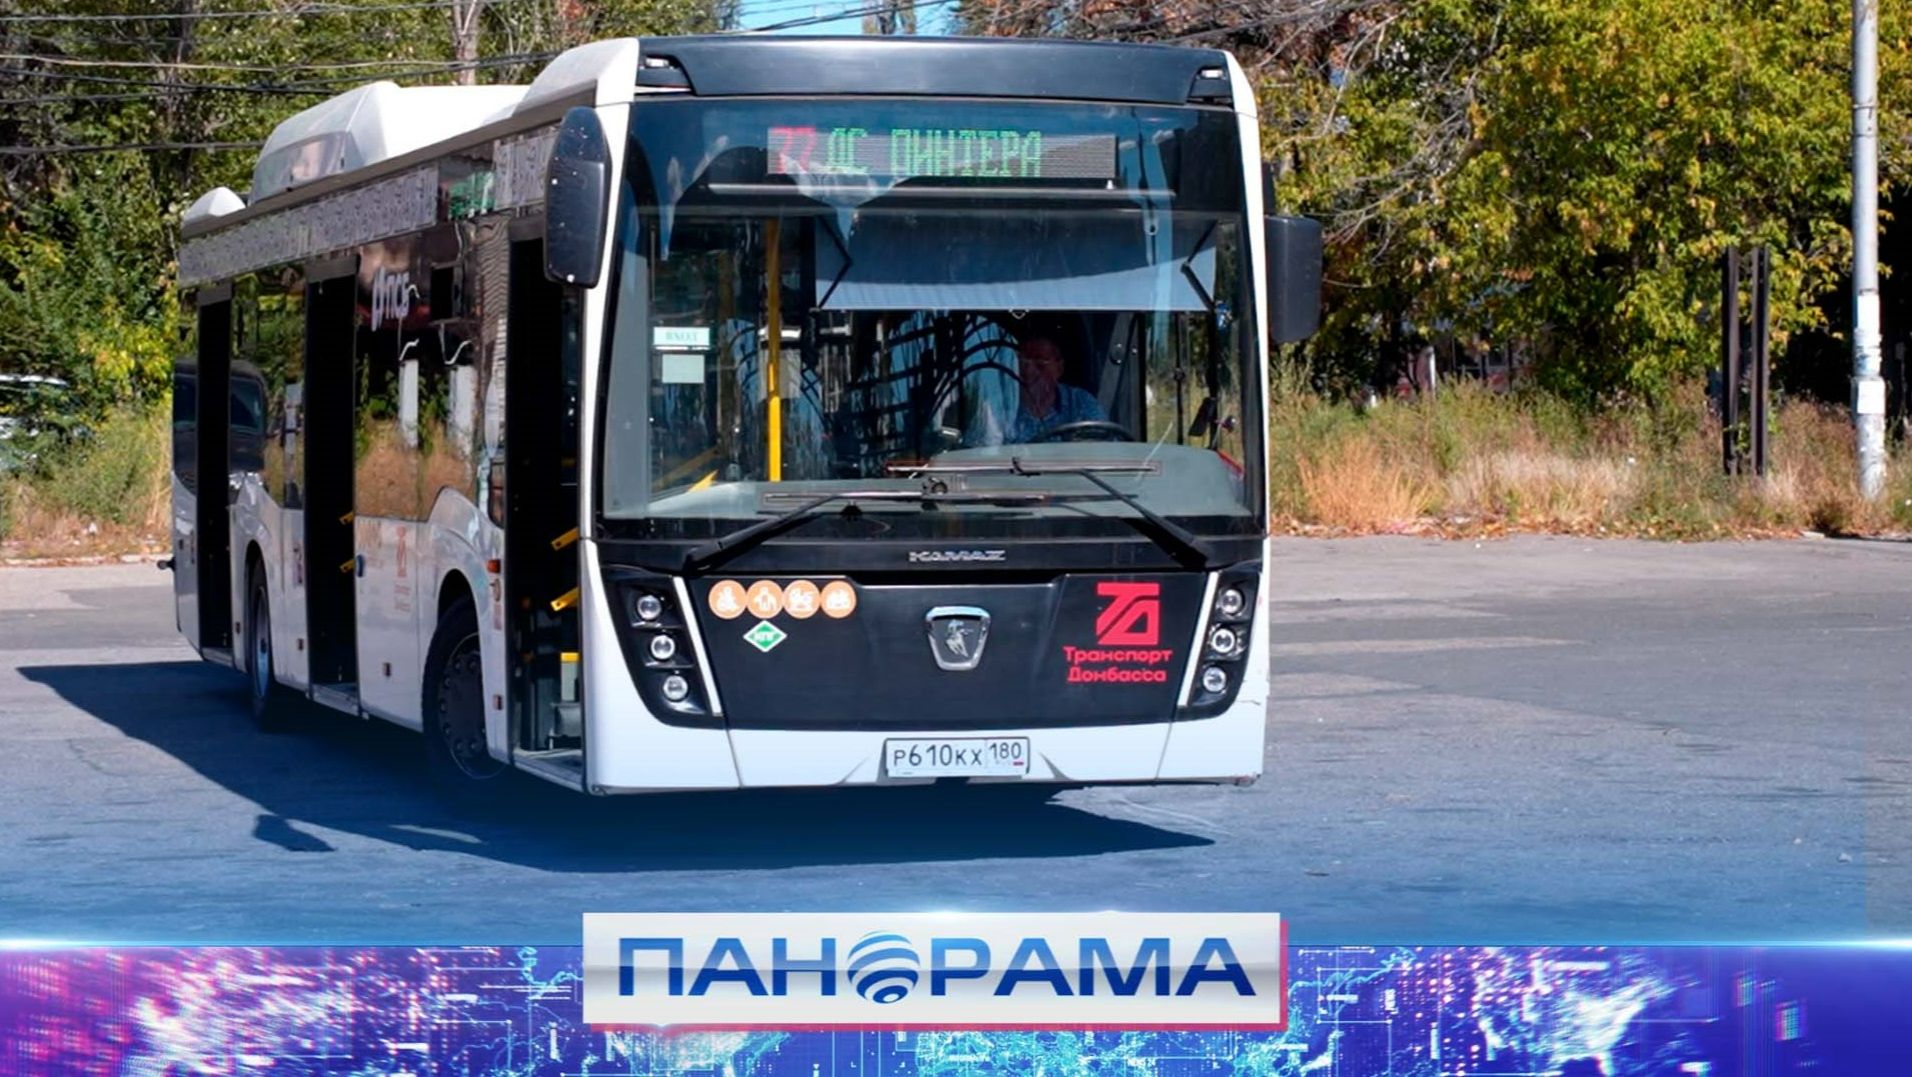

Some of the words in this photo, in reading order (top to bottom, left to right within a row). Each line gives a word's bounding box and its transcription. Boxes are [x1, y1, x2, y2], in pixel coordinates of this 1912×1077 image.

[771, 126, 816, 175] 77
[891, 128, 1042, 177] ПИНТЕРА
[908, 550, 1006, 562] KAMAZ
[1063, 646, 1173, 664] Транспорт
[1067, 666, 1167, 683] Донбасса
[989, 742, 1022, 759] 180
